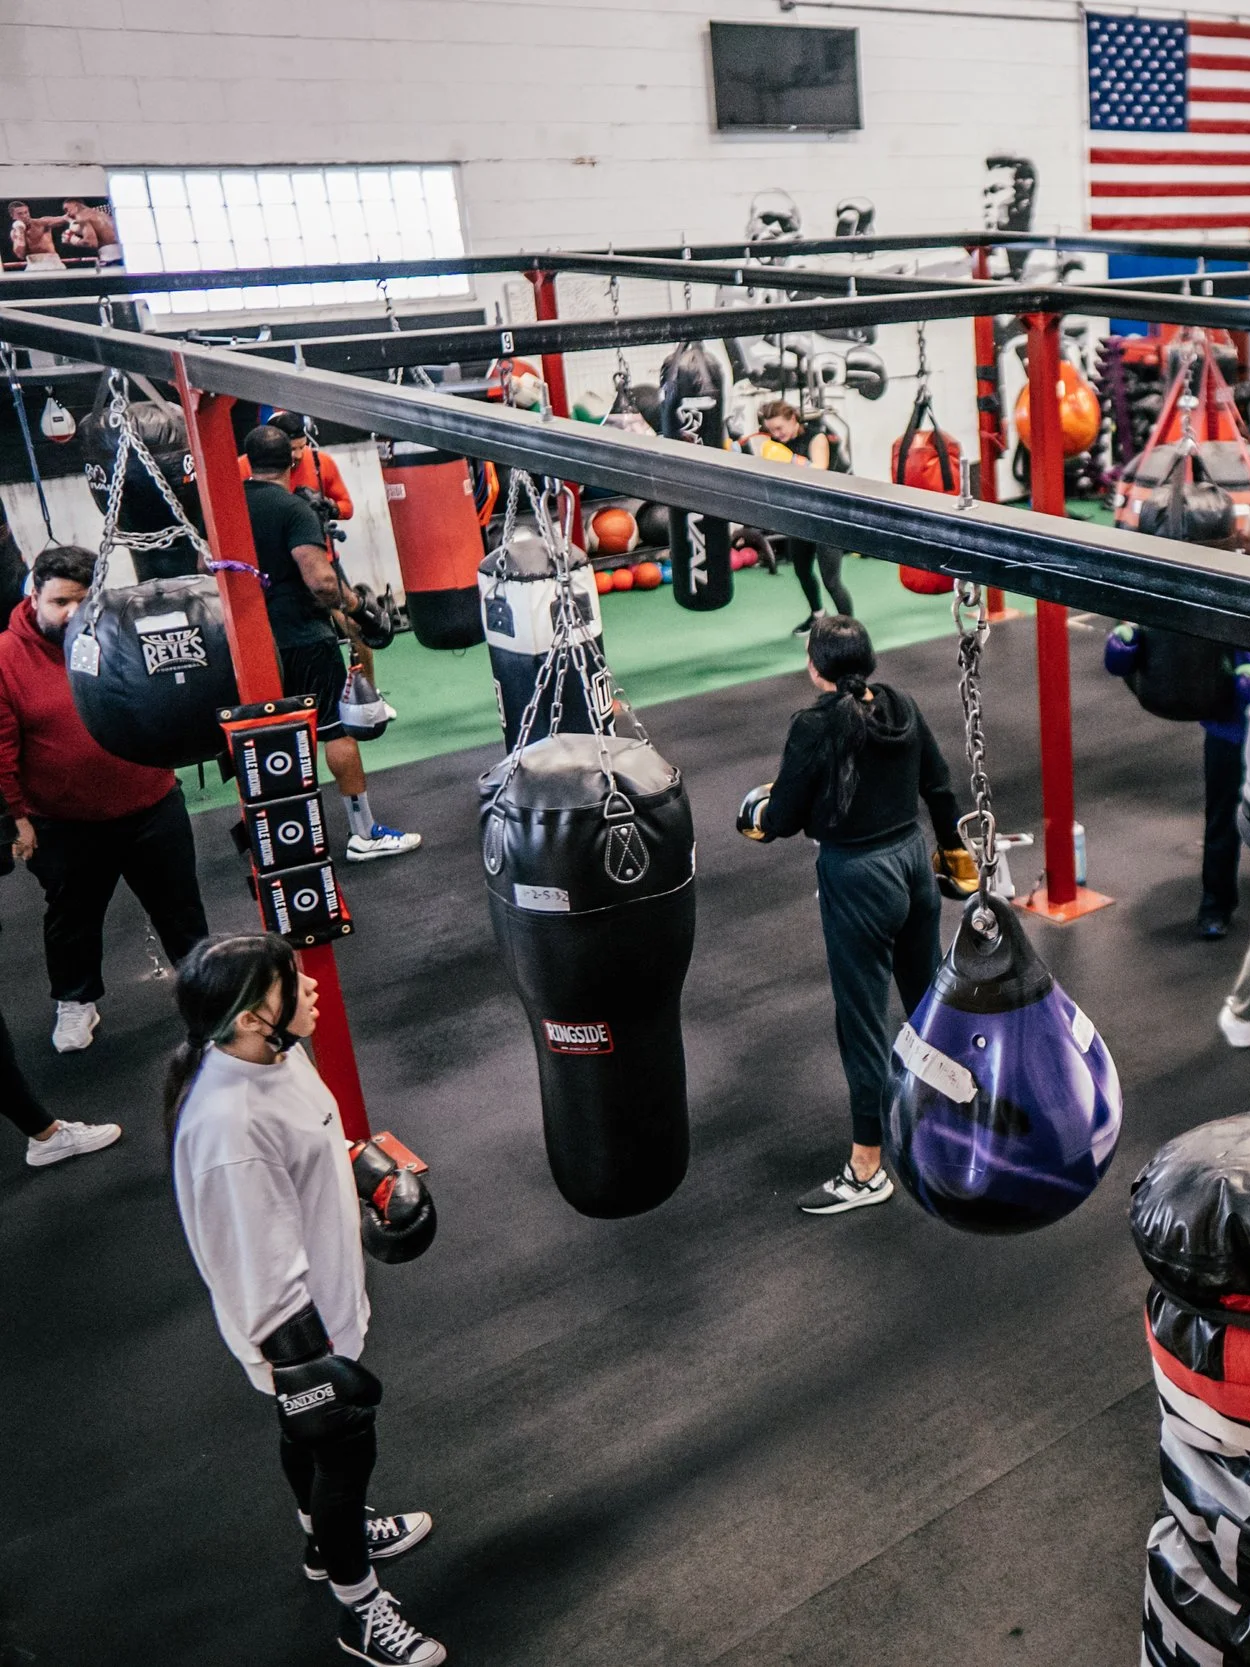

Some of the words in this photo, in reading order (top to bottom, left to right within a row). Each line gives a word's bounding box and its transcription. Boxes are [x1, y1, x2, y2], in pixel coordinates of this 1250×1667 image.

[503, 334, 512, 350] 9
[687, 512, 709, 595] VAL
[142, 636, 206, 675] REYES
[244, 748, 258, 769] TITLE
[300, 757, 313, 779] TITLE
[256, 818, 270, 839] TITLE
[311, 825, 324, 846] TITLE
[272, 887, 286, 908] TITLE
[325, 891, 338, 912] TITLE
[545, 1022, 608, 1043] RINGSIDE
[283, 1385, 336, 1411] BOXING
